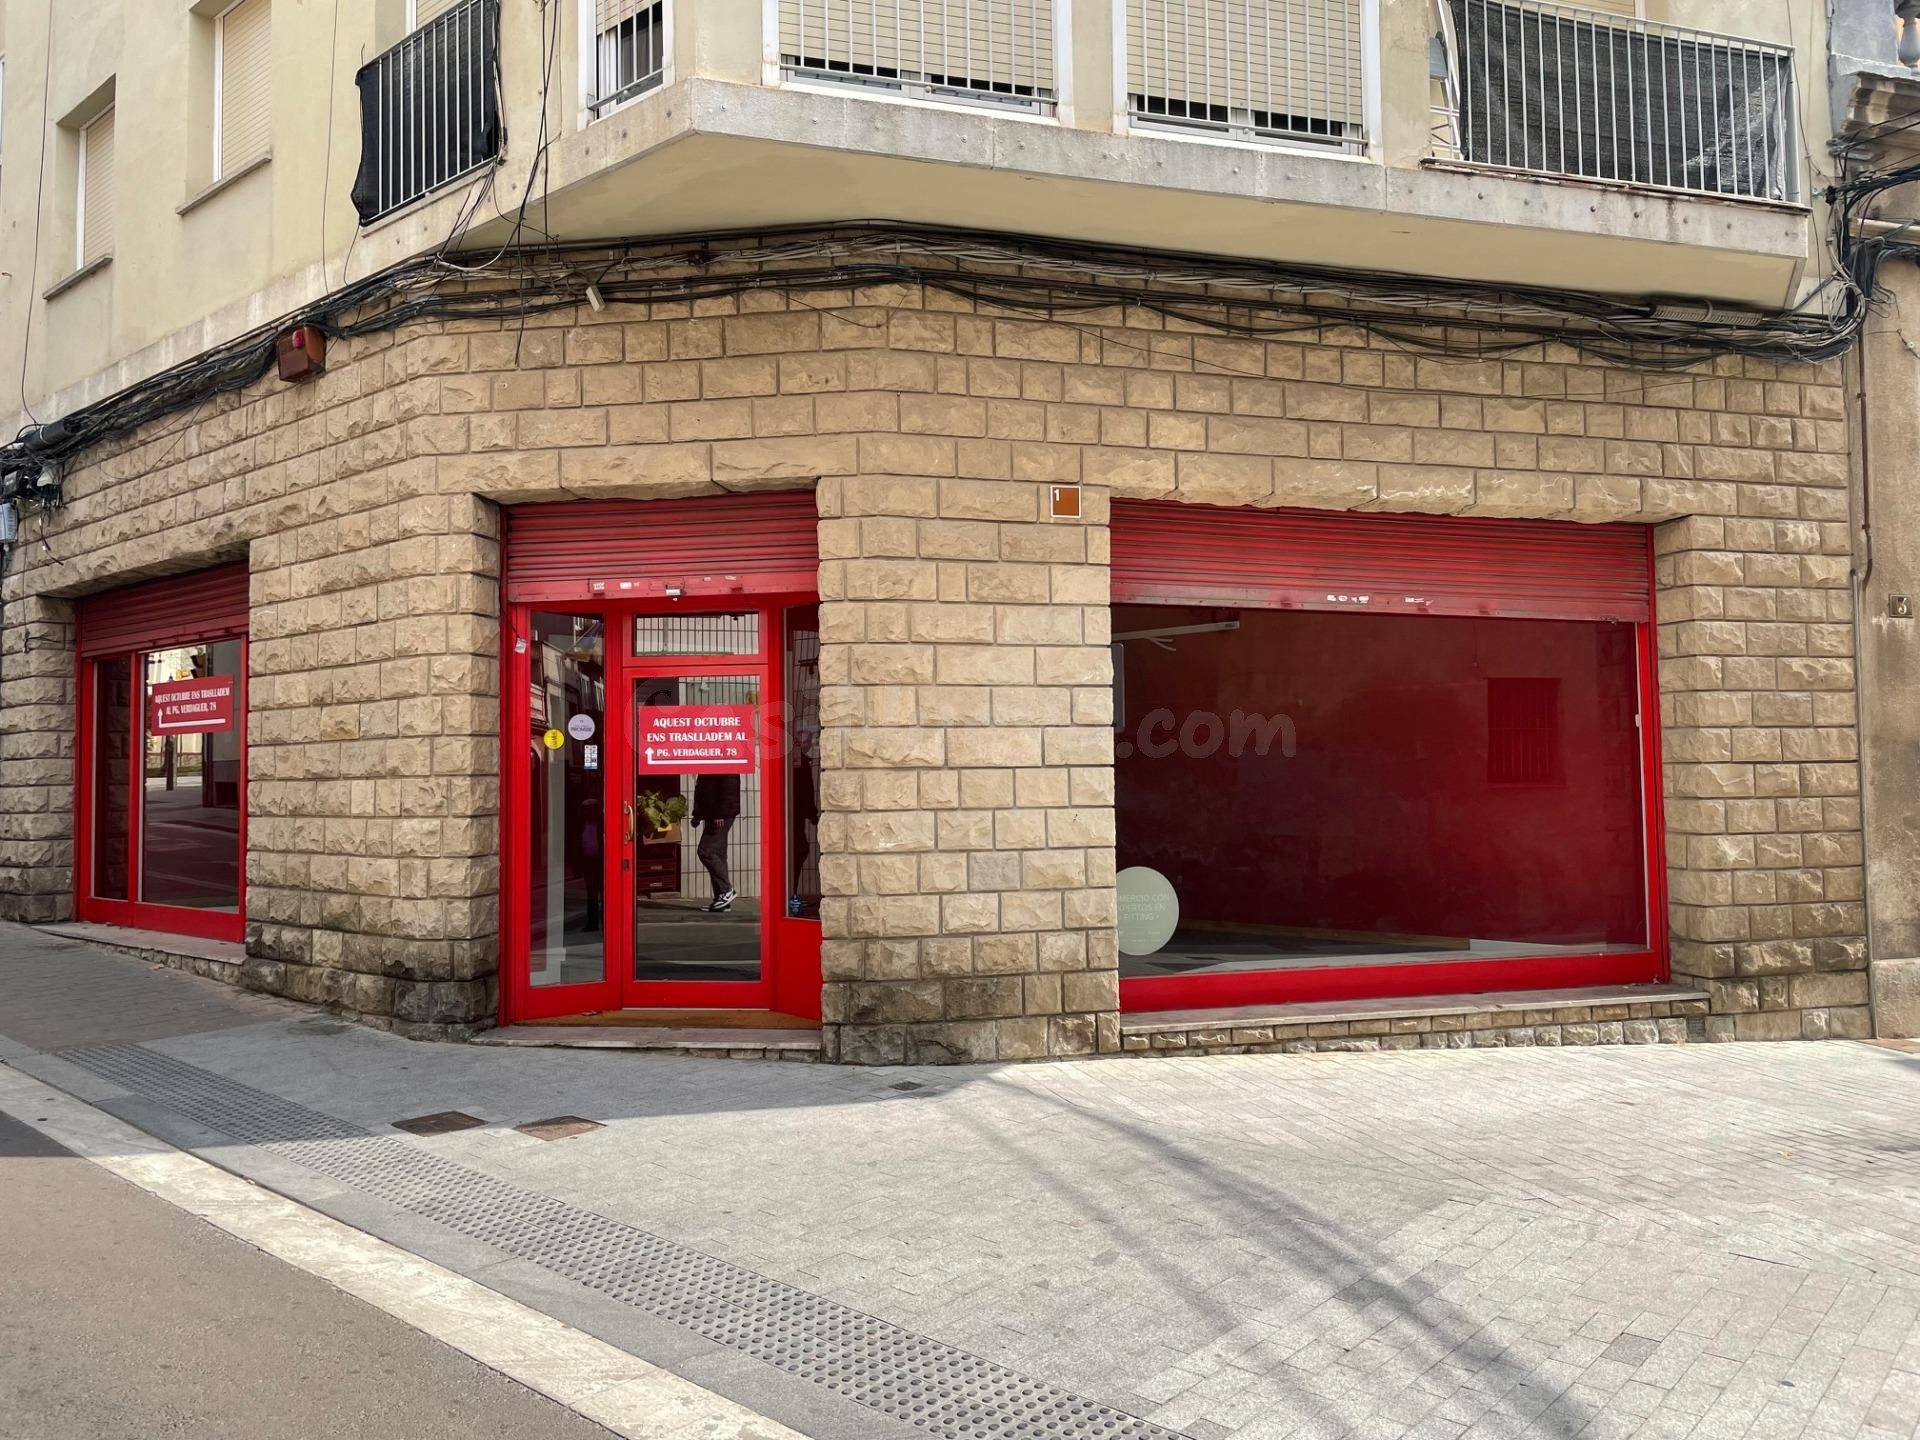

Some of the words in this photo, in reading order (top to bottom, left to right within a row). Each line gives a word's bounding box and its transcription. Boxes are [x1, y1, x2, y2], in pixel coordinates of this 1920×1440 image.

[1054, 488, 1060, 502] 1
[191, 690, 201, 700] ENS
[653, 717, 692, 728] AQUEST
[694, 716, 741, 727] OCTUBRE
[647, 732, 666, 742] ENS
[669, 732, 732, 742] TRASLLADEM
[735, 731, 748, 741] AL
[657, 748, 671, 757] PG.
[673, 748, 724, 757] VERDAGUER,
[726, 747, 737, 757] 78
